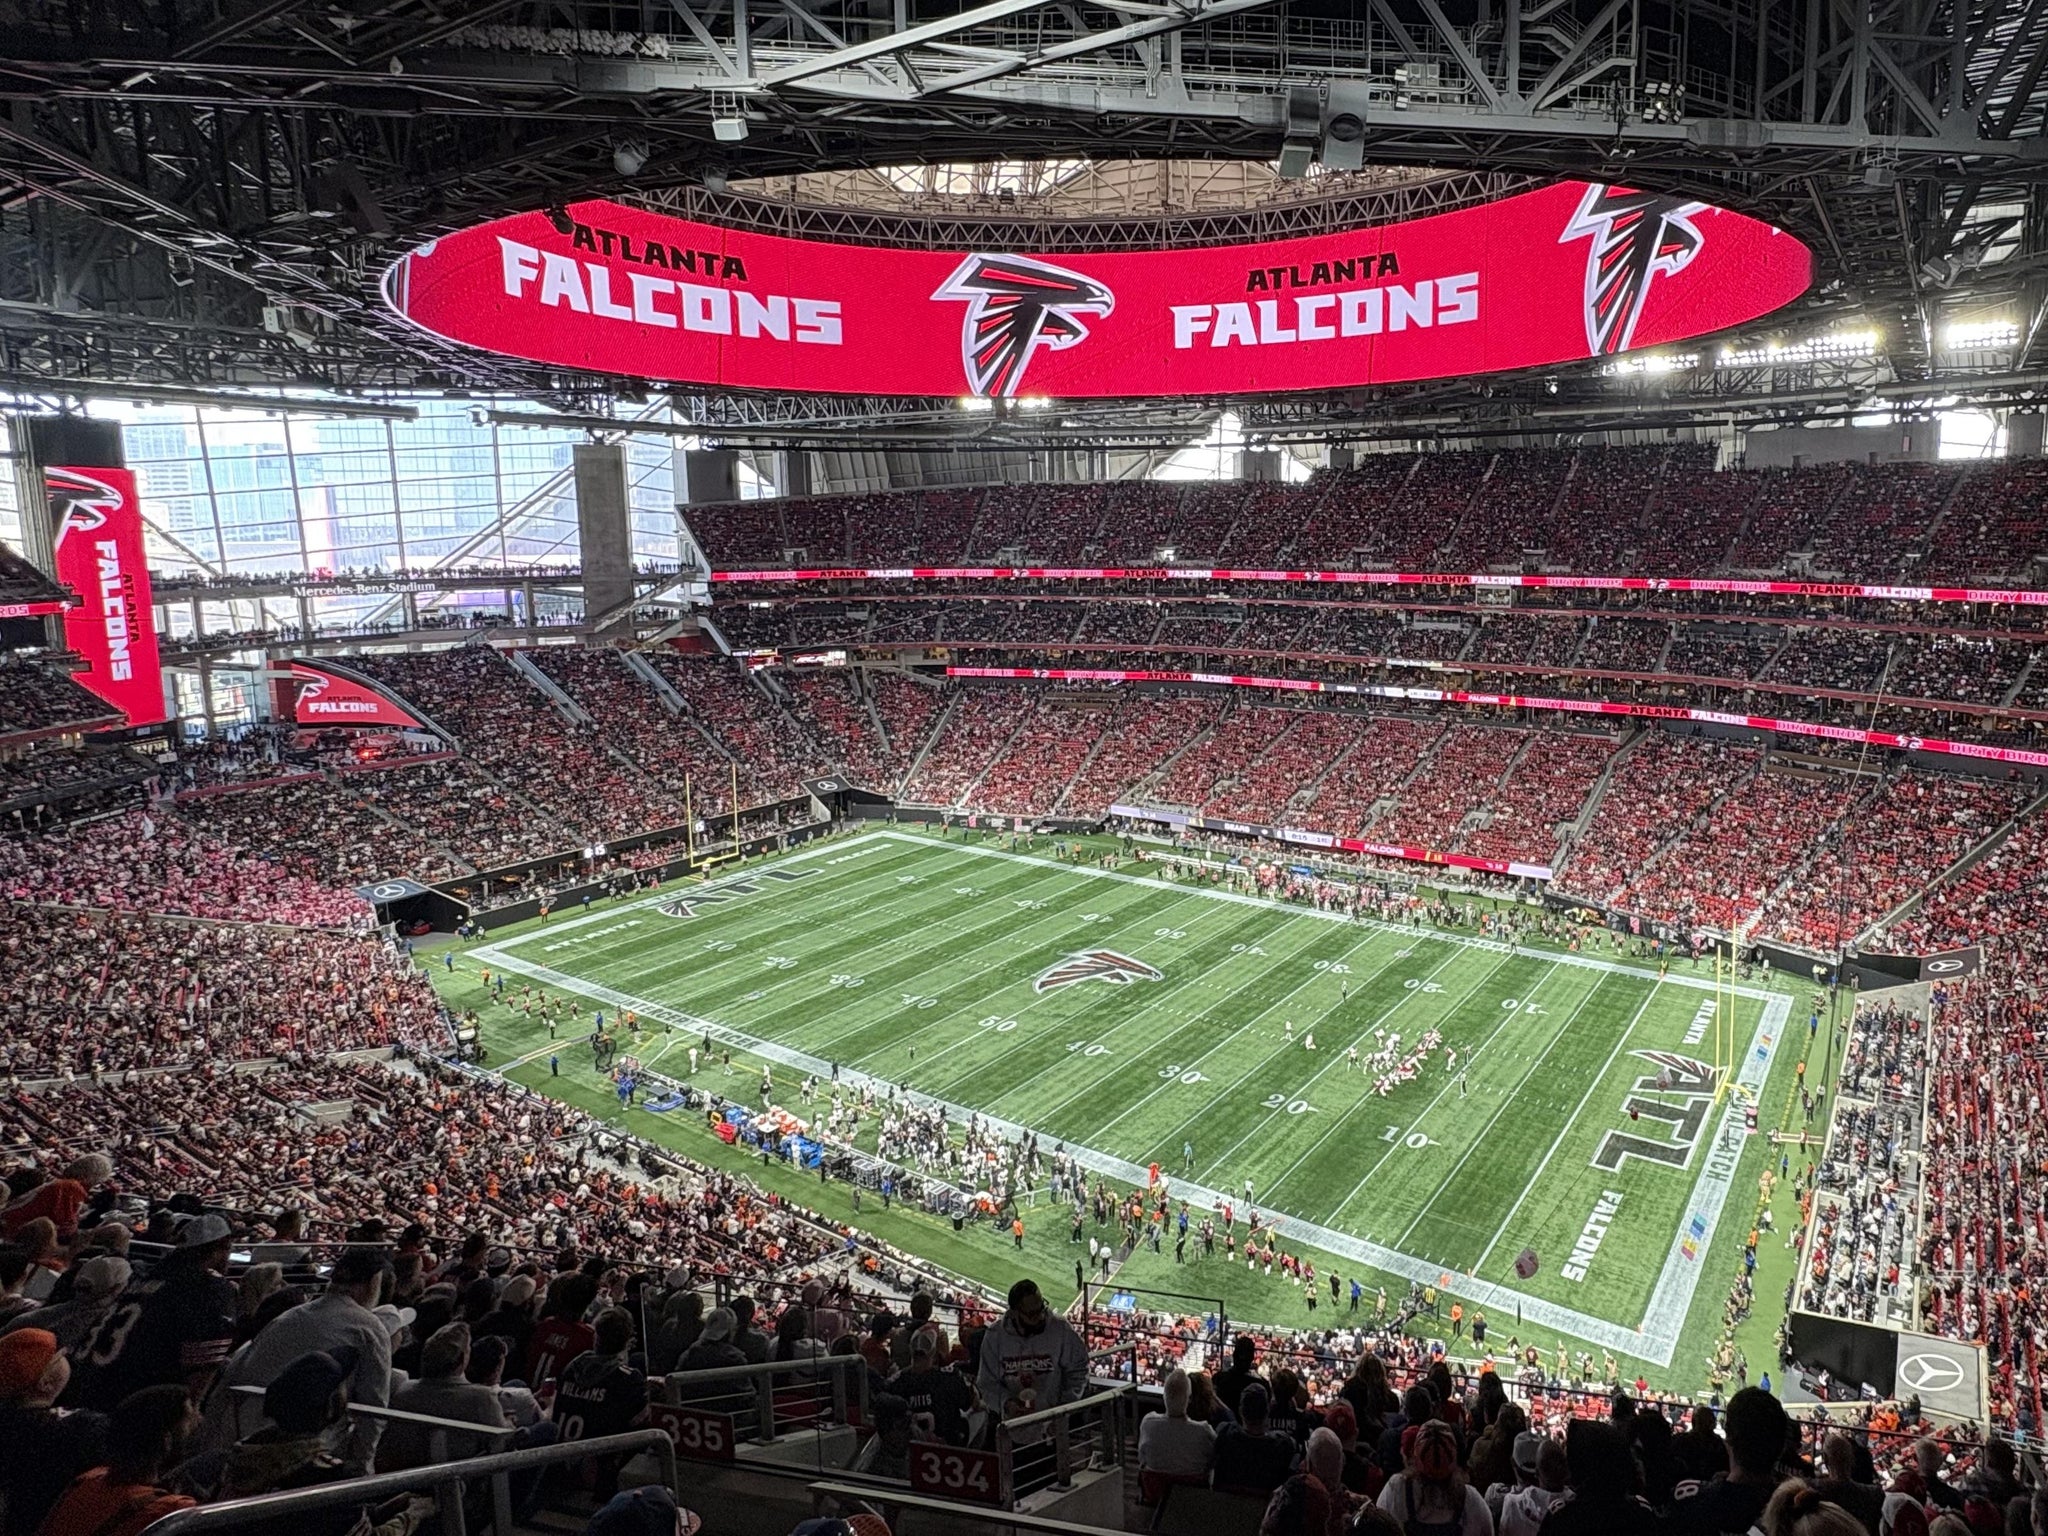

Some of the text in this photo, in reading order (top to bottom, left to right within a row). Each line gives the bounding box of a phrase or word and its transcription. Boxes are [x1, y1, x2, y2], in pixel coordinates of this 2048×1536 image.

[573, 224, 747, 281] ATLANTA
[1247, 252, 1399, 293] ATLANTA
[497, 236, 842, 345] FALCONS
[1173, 273, 1478, 348] FALCONS
[293, 582, 436, 598] Mercedes-Benz Stadium
[1422, 575, 1522, 585] ATLANTA FALCONS
[1690, 581, 1771, 591] DIRTY BIRDS
[1800, 584, 1932, 599] ATLANTA FALCONS
[1968, 591, 2017, 602] DIRTY
[95, 541, 132, 681] FALCONS
[123, 573, 140, 643] ATLANTA
[308, 702, 378, 713] FALCONS
[1630, 705, 1747, 725] ATLANTA FALCONS
[1777, 721, 1866, 740] DIRTY BIRDS
[1951, 744, 2002, 759] DIRTY
[1364, 844, 1404, 857] FALCONS
[543, 920, 642, 952] ATLANTA
[829, 974, 865, 988] 30
[1404, 979, 1443, 993] 20
[900, 993, 938, 1009] 40
[618, 998, 762, 1050] INTERCEPT CANCER
[978, 1015, 1018, 1032] 50
[1683, 999, 1719, 1045] ATLANTA
[1065, 1040, 1104, 1056] 40
[1158, 1064, 1202, 1085] 30
[1260, 1093, 1309, 1115] 20
[1590, 1049, 1731, 1173] ATL
[1378, 1125, 1429, 1149] 10
[1561, 1190, 1624, 1283] FALCONS
[561, 1381, 606, 1402] WILLIAMS
[662, 1414, 723, 1452] 335
[920, 1452, 990, 1493] 334
